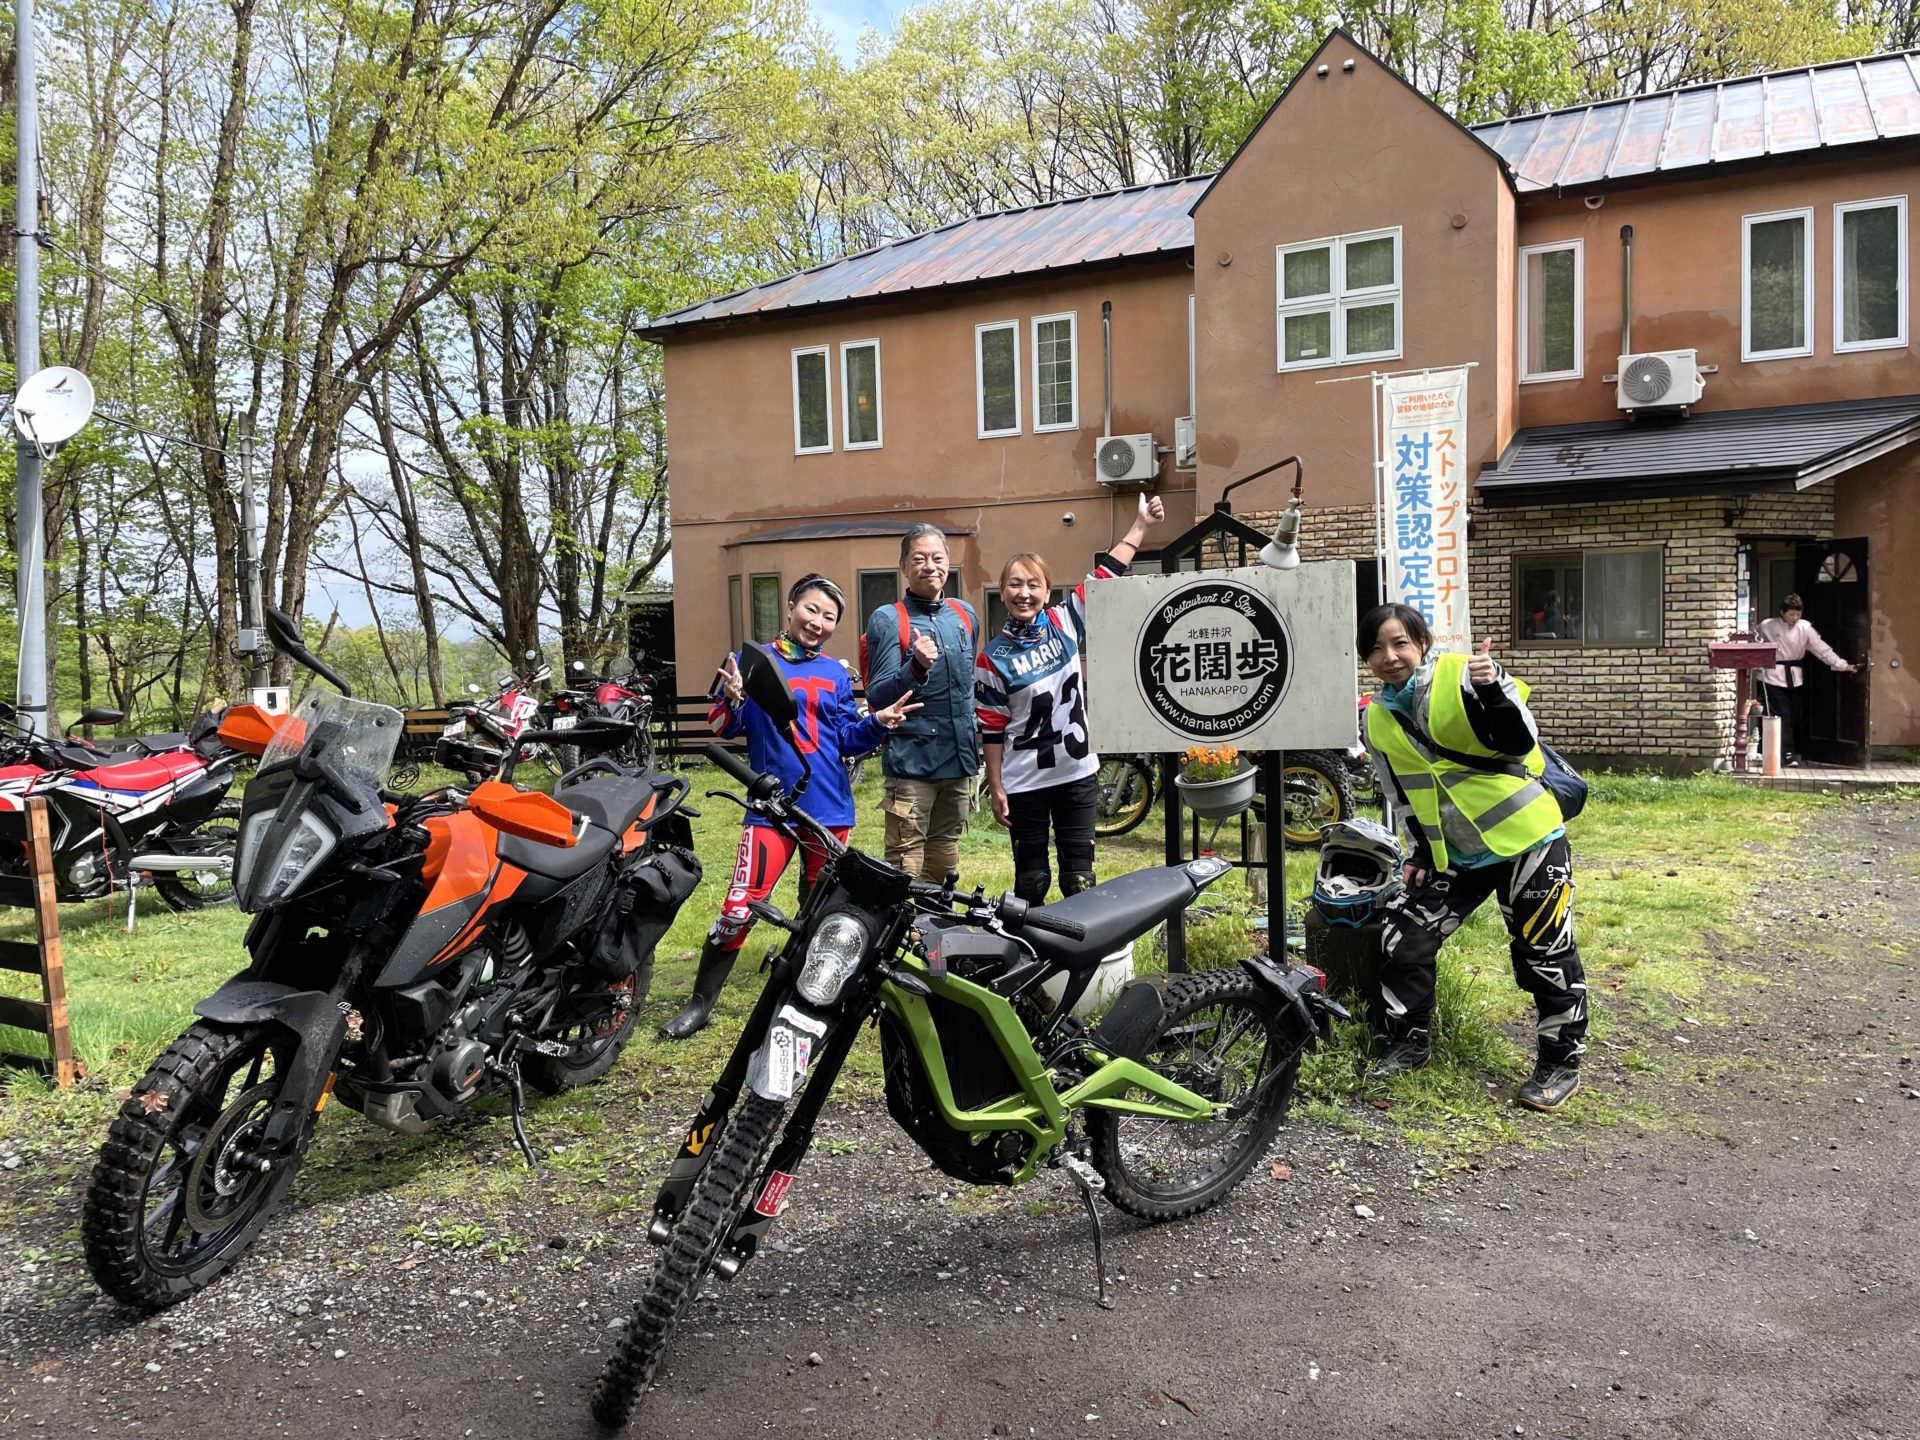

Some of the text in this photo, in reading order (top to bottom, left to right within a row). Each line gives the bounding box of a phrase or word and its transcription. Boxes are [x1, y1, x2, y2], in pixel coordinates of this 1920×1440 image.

[1395, 431, 1435, 628] 対策認定店
[1163, 591, 1256, 623] Restaurant & Stay
[1187, 626, 1232, 639] 北軽井沢
[1151, 638, 1278, 686] 花闊歩
[1155, 683, 1275, 731] www.hanakappo.com
[1180, 685, 1248, 697] HANAKAPPO
[1013, 671, 1089, 770] 43
